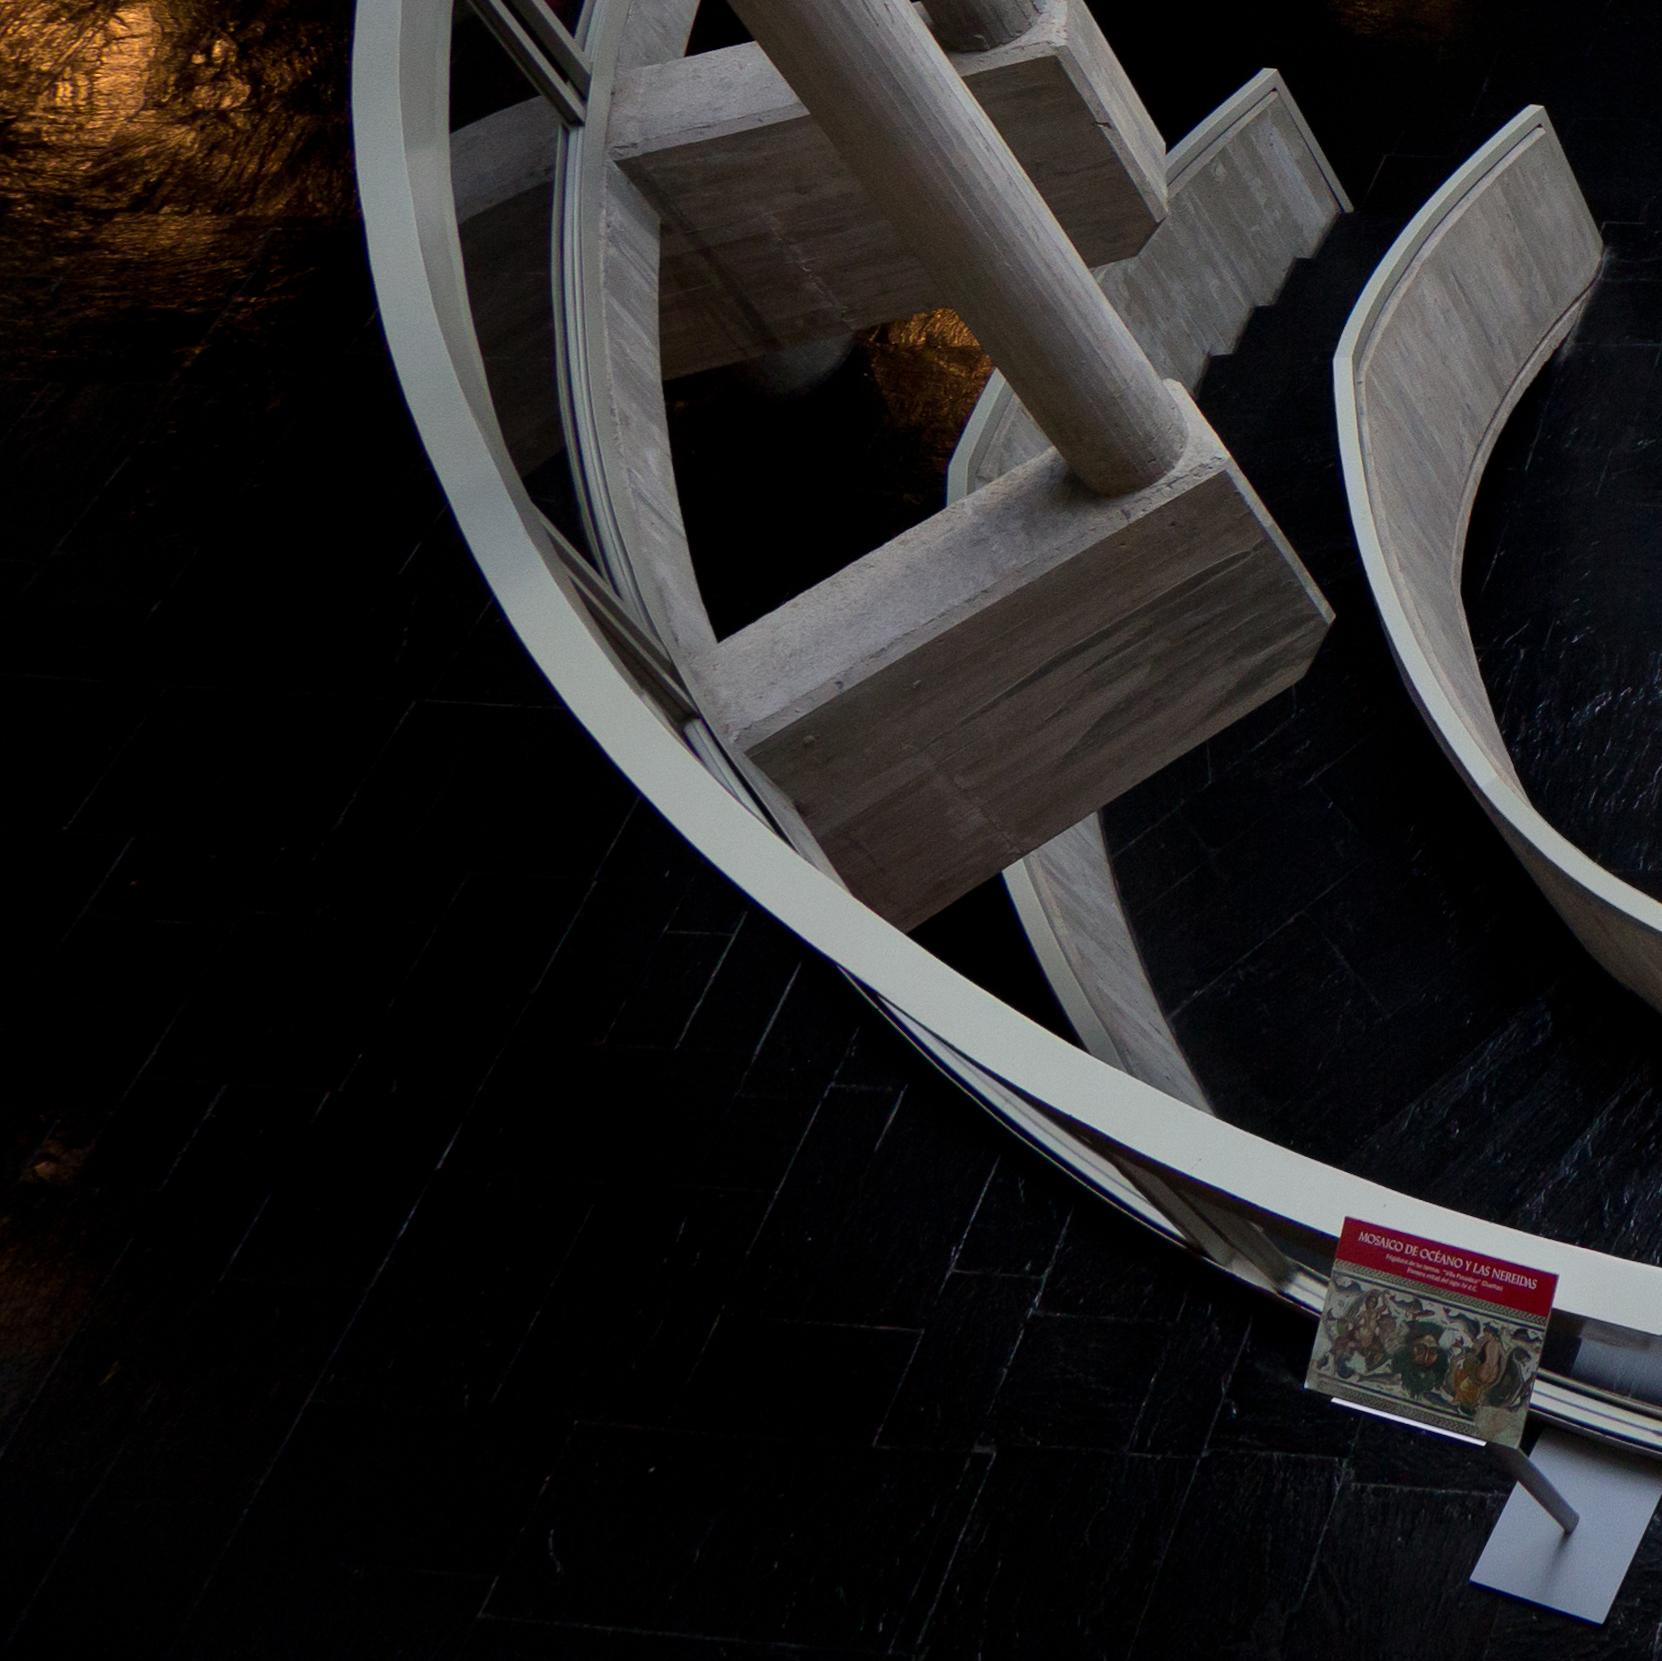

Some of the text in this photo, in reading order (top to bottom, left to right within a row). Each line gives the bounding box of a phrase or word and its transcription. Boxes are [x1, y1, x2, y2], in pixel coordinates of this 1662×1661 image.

[1358, 1231, 1538, 1290] MOSAICO DE OCÉANO Y LAS NEREIDAS
